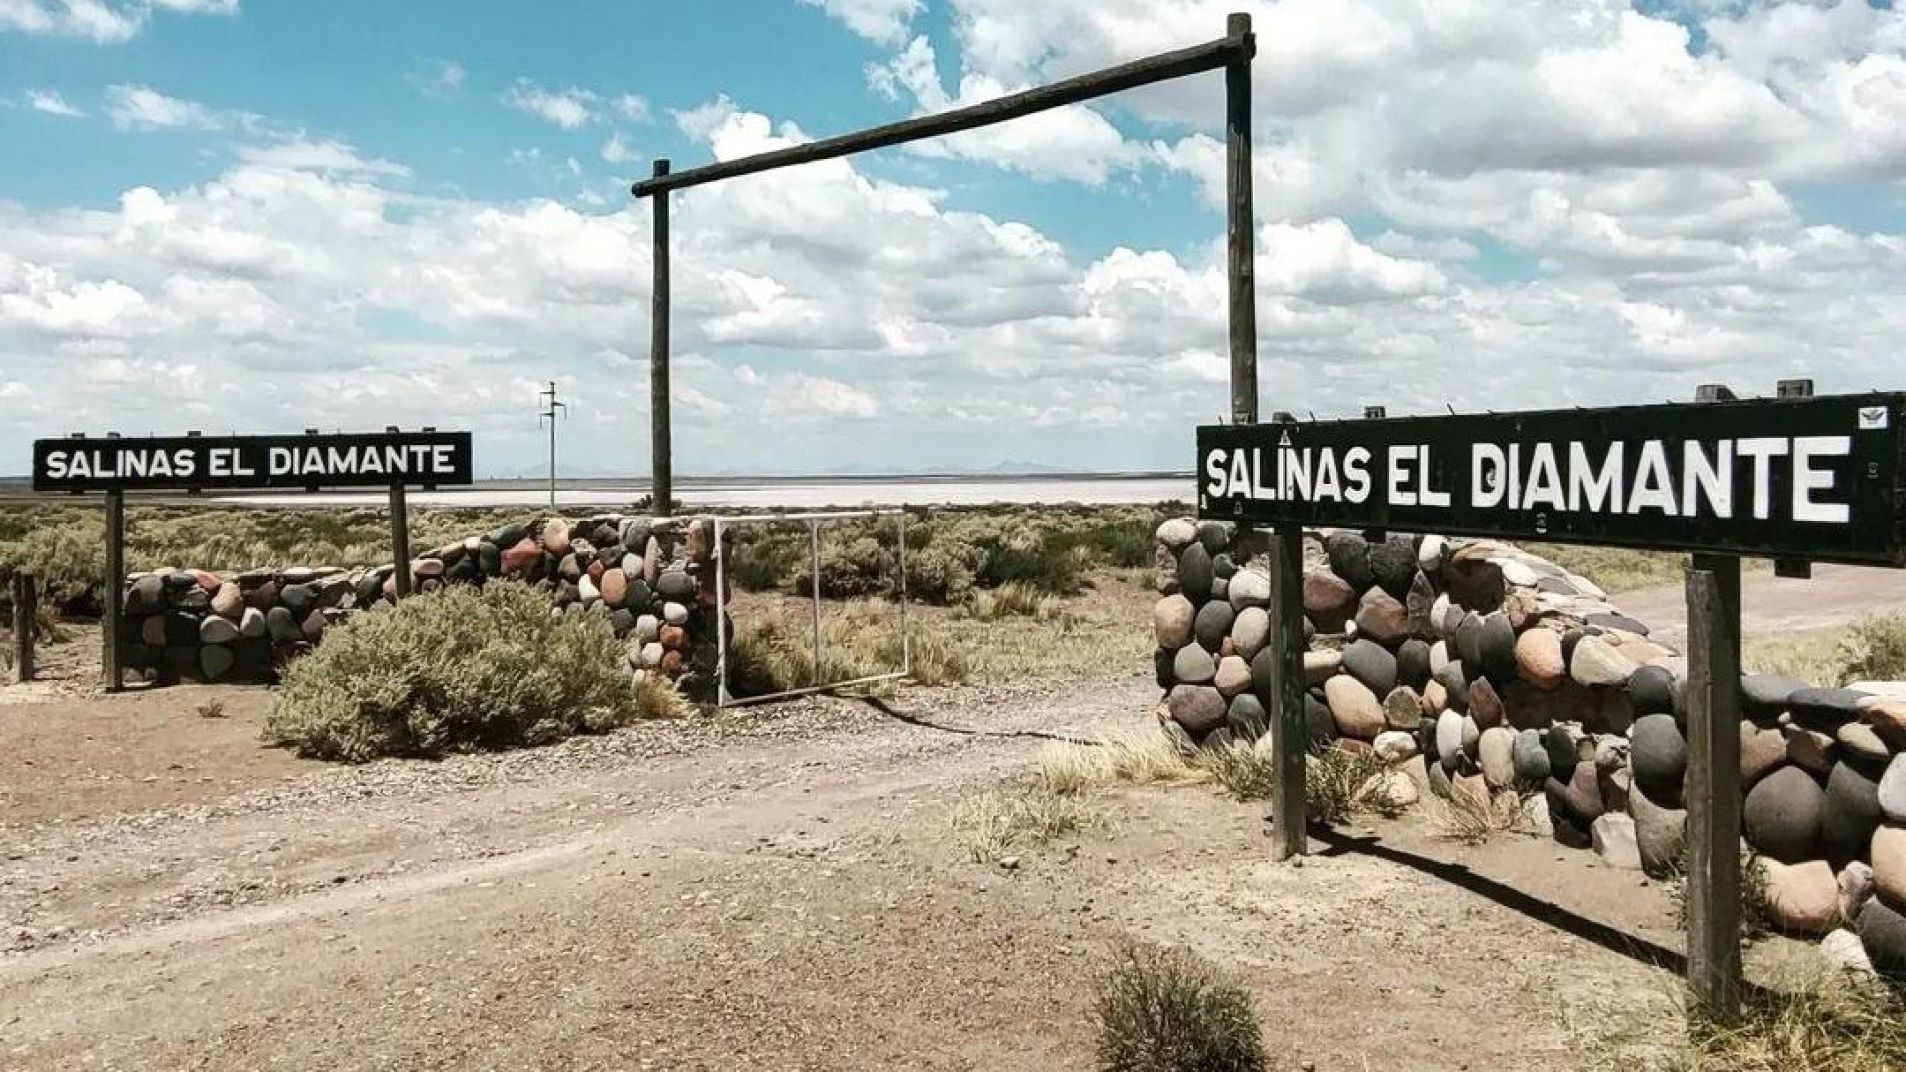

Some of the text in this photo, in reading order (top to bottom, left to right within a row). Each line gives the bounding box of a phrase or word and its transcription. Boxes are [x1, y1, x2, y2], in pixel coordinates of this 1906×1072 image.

[46, 444, 455, 478] SALINAS EL DIAMANTE
[1206, 435, 1851, 524] SALINAS EL DIAMANTE
